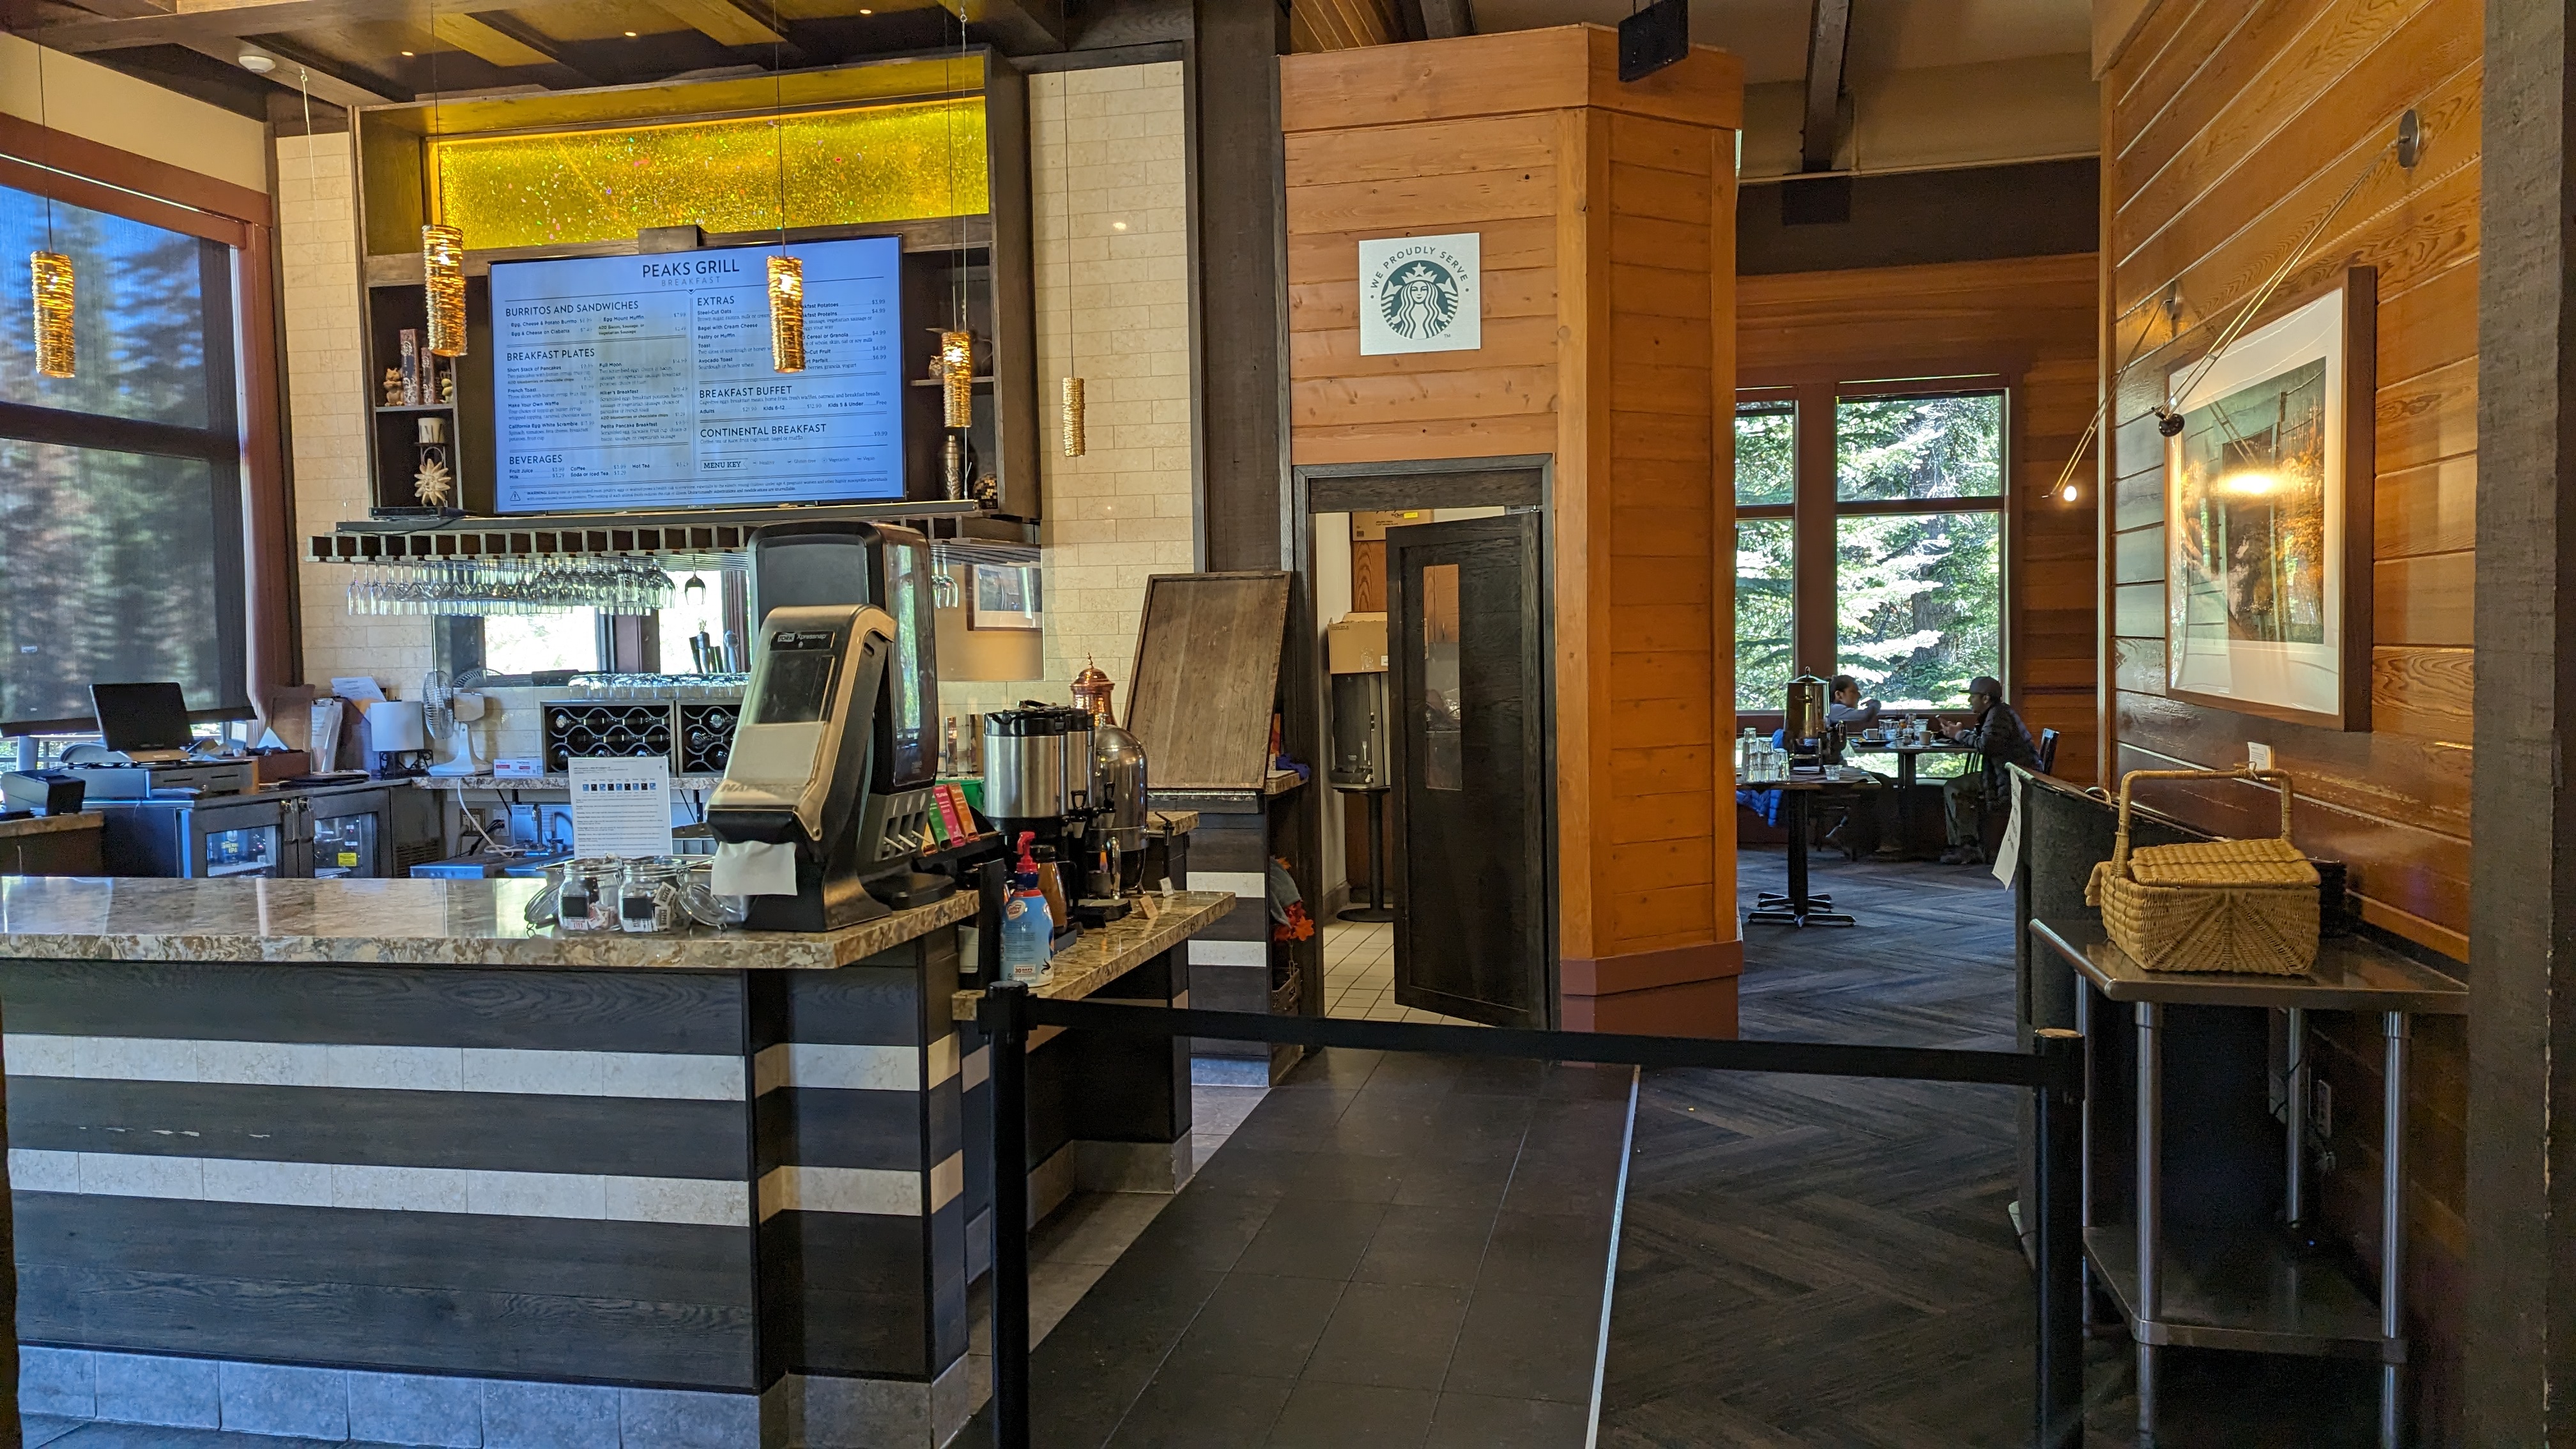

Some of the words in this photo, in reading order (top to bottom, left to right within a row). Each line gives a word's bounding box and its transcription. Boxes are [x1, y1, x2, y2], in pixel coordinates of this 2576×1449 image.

[643, 262, 690, 277] PEAKS
[696, 259, 739, 274] GRILL
[1370, 271, 1383, 288] WE
[1383, 246, 1436, 269] PROUDLY
[1439, 251, 1468, 282] SERVE
[661, 276, 720, 286] BREAKFAST
[698, 296, 734, 306] EXTRAS
[506, 306, 551, 316] BURRITOS
[554, 305, 574, 314] AND
[576, 301, 638, 313] SANDWICHES
[507, 350, 559, 361] BREAKFAST
[562, 348, 595, 358] PLATES
[699, 387, 753, 399] BREAKFAST
[756, 385, 792, 395] BUFFET
[700, 427, 769, 438] CONTINENTAL
[772, 424, 827, 434] BREAKFAST
[509, 454, 562, 464] BEVERAGES
